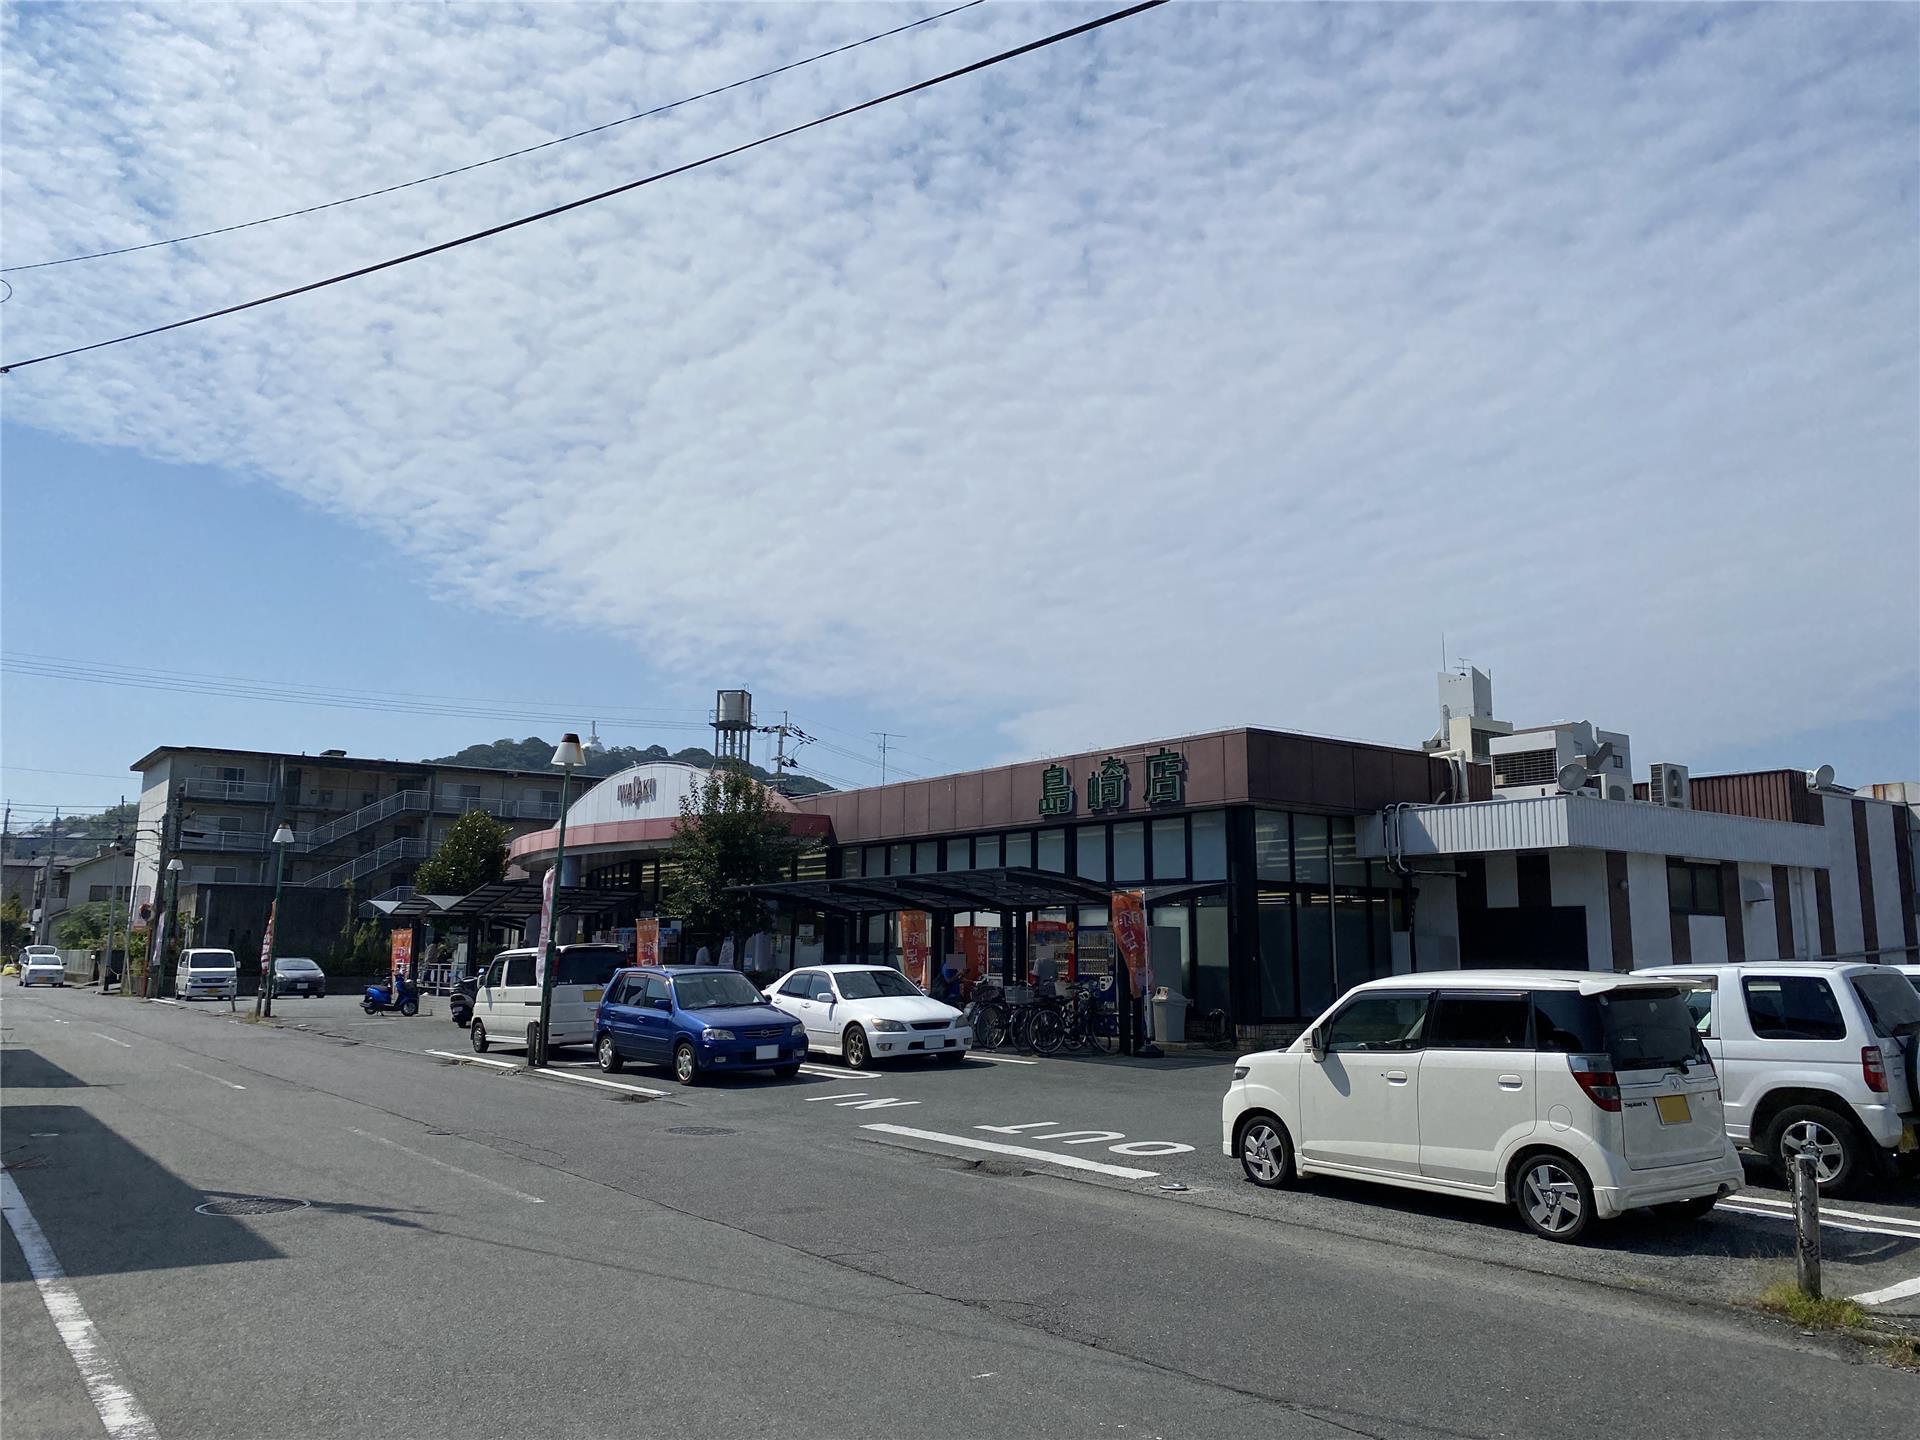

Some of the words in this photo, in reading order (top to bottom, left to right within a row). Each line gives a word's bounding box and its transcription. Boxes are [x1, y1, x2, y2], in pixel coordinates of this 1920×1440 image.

[1039, 747, 1182, 816] 島崎店
[804, 1093, 922, 1110] IN
[973, 1121, 1197, 1156] OUT
